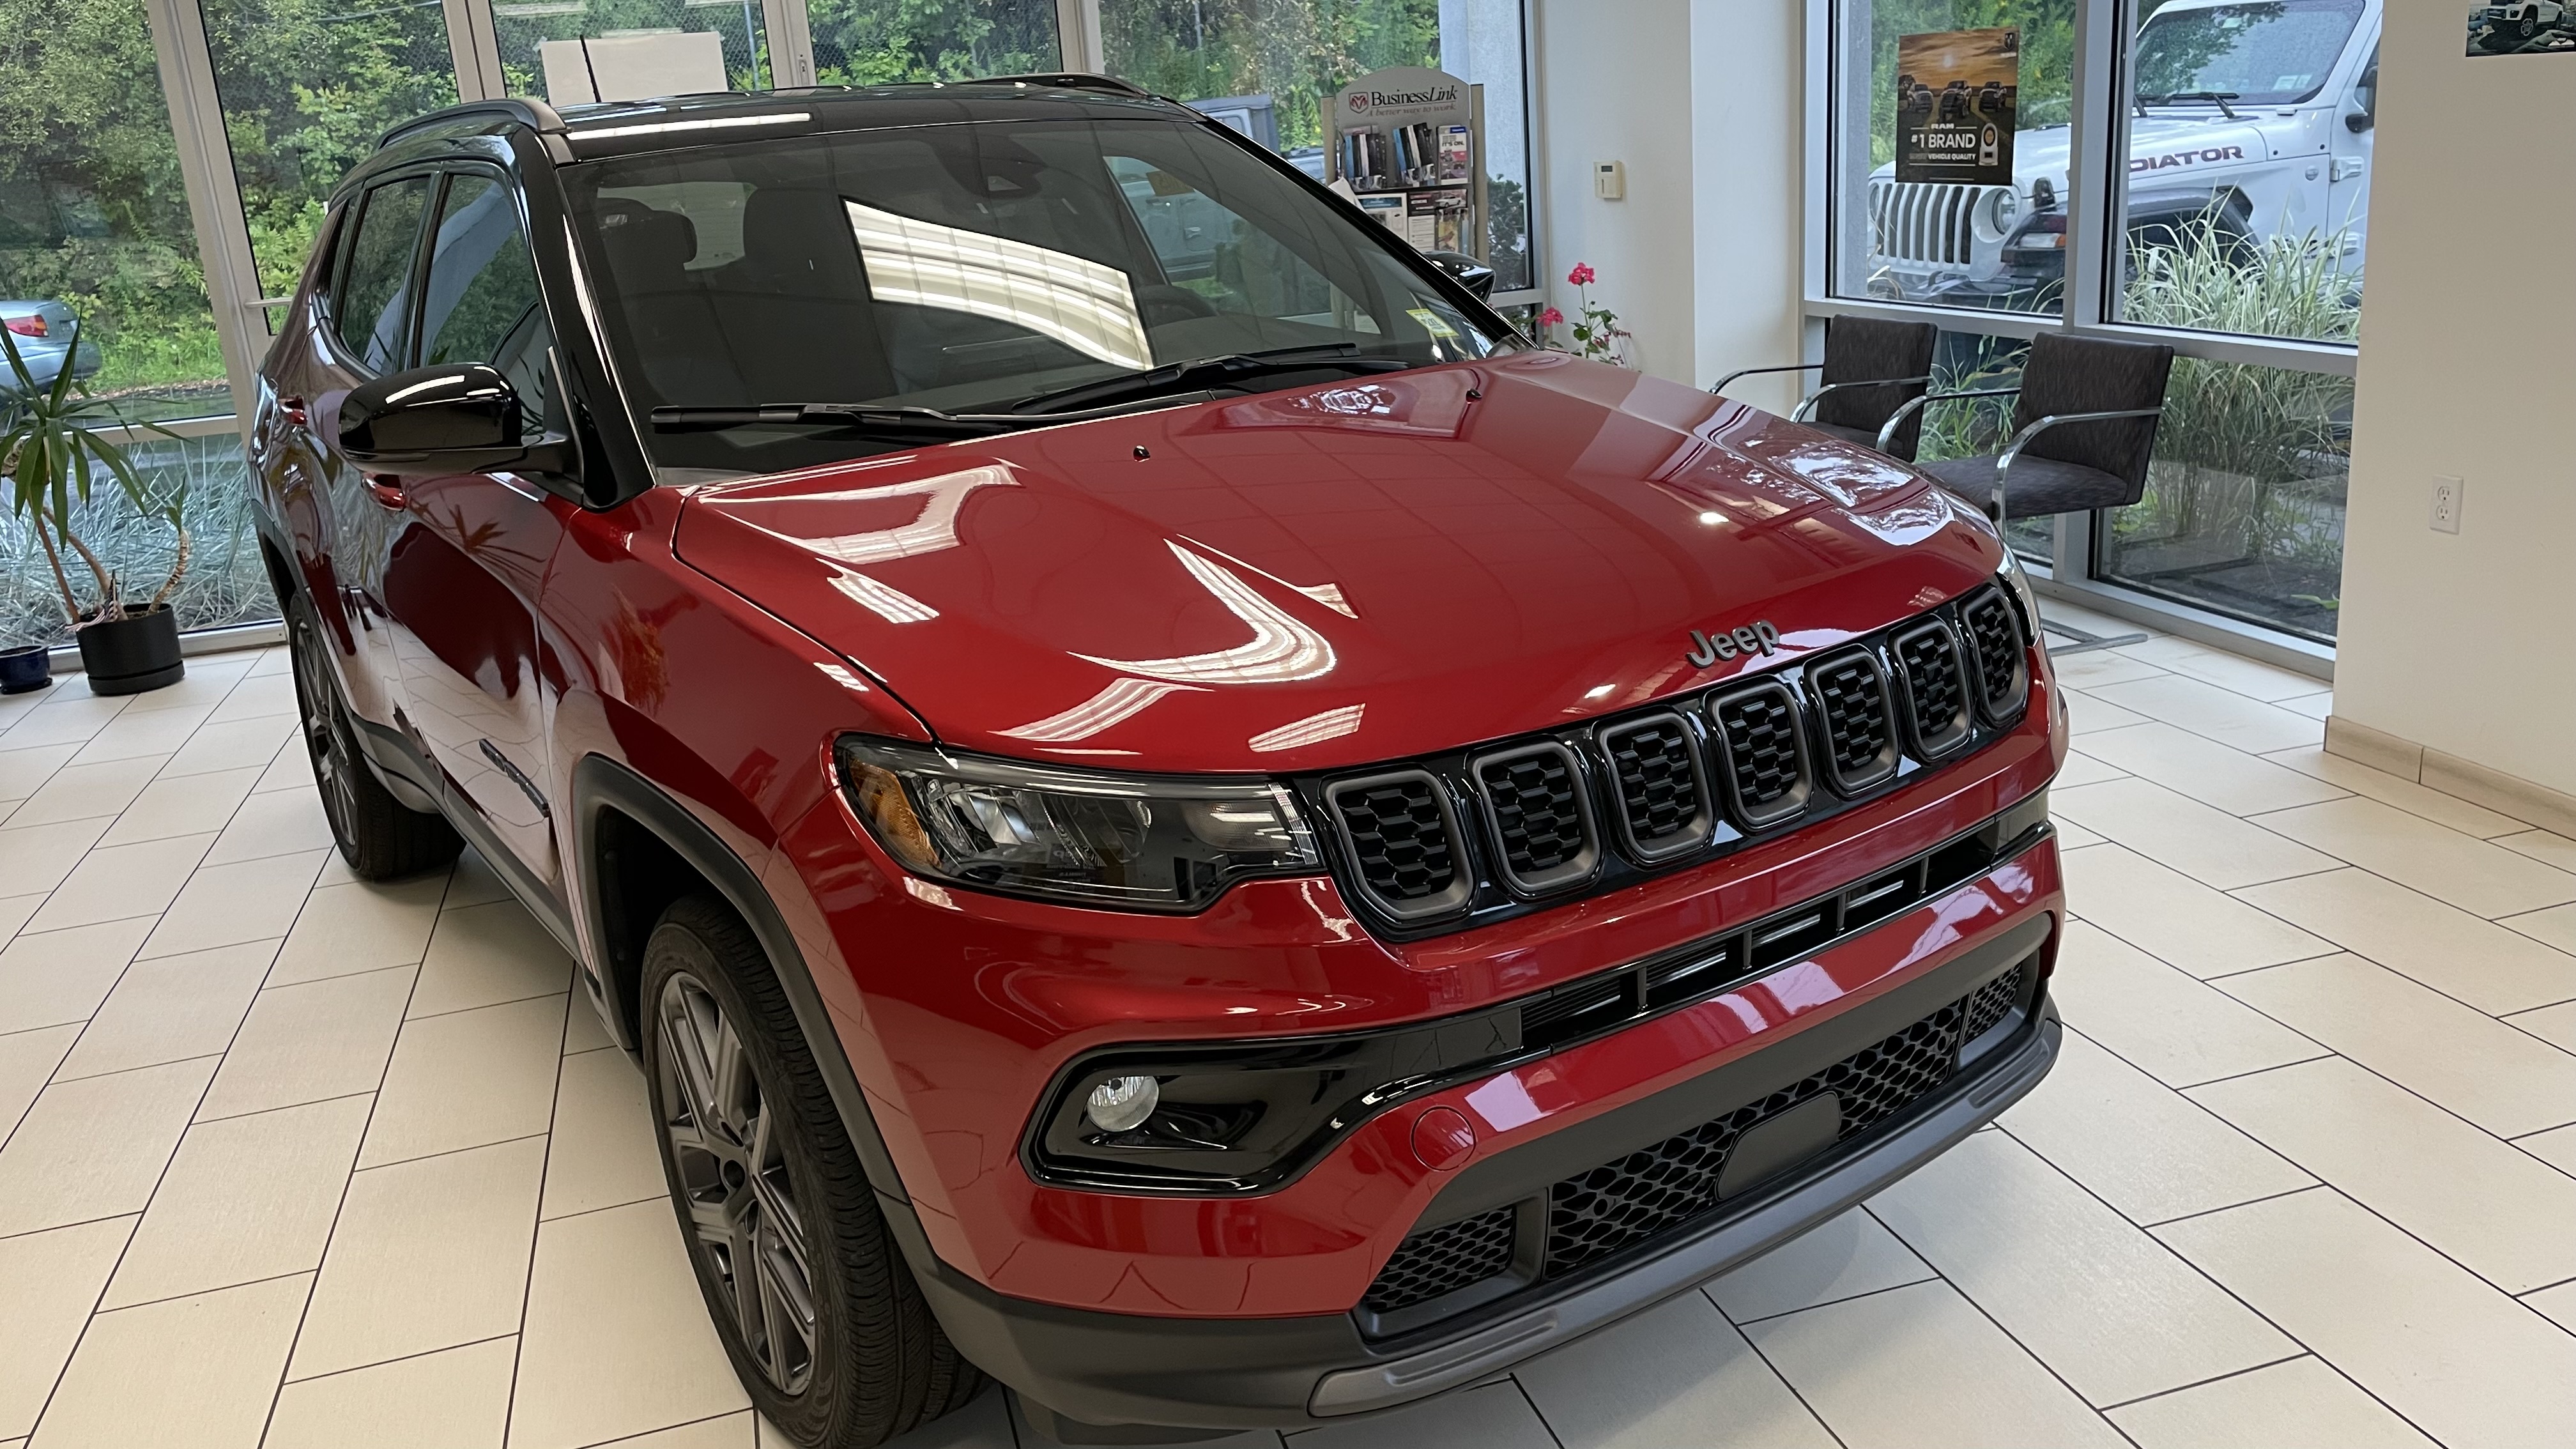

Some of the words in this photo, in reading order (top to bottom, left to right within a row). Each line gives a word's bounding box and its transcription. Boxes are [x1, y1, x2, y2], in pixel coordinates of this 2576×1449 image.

[1371, 85, 1458, 106] BusinessLink
[1928, 133, 1976, 148] BRAND
[2129, 146, 2244, 172] DIATOR
[1685, 619, 1781, 668] Jeep
